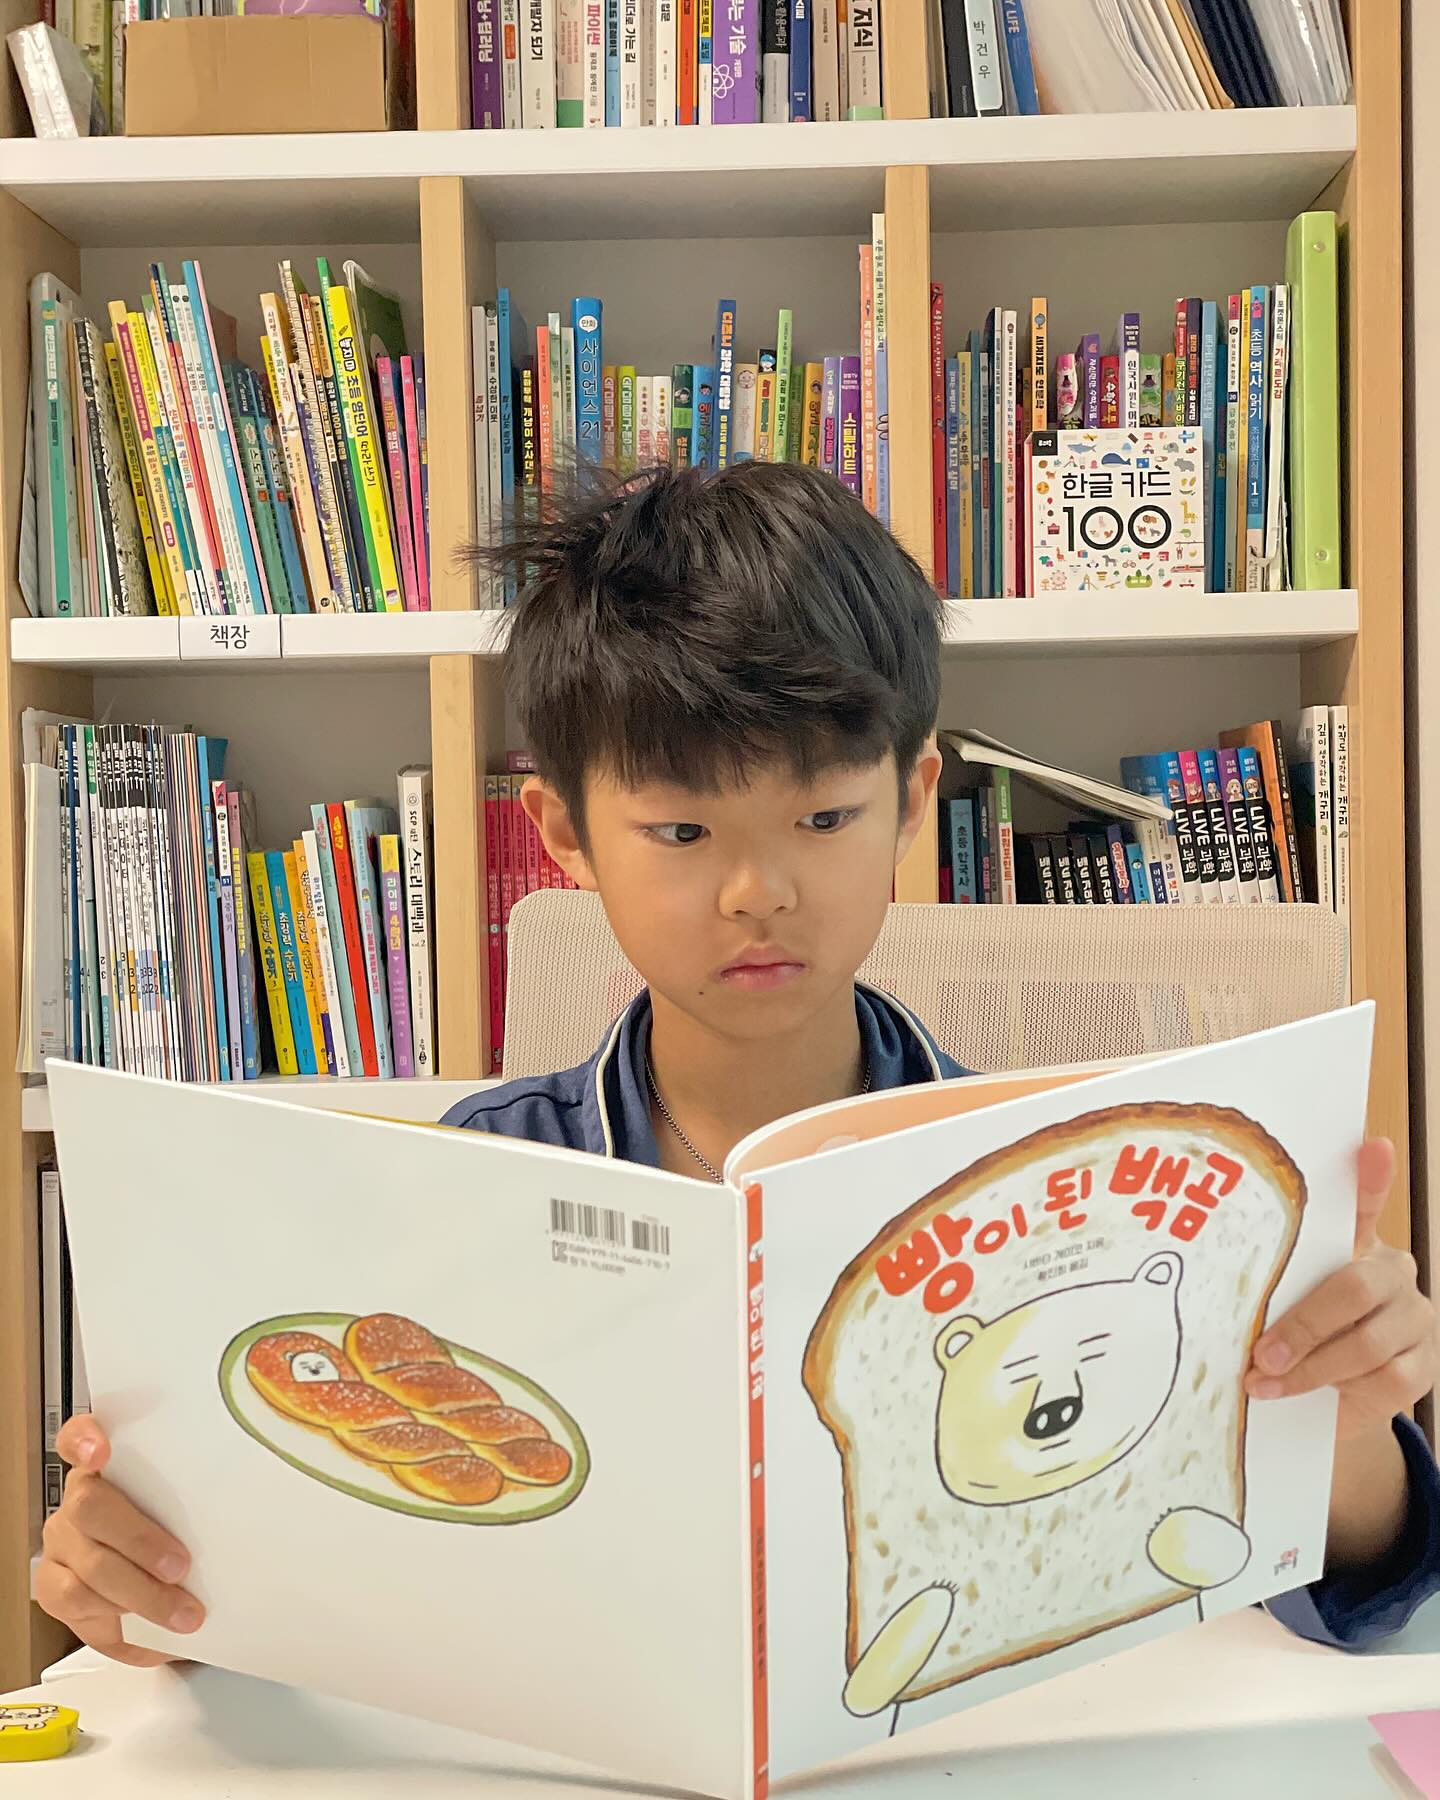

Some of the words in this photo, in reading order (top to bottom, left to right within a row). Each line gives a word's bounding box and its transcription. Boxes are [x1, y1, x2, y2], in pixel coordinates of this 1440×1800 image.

[587, 4, 601, 46] 파이썬
[661, 3, 671, 22] 입문
[1005, 10, 1020, 33] LIFE
[625, 28, 637, 50] 가는
[729, 25, 746, 55] 기술
[853, 8, 874, 47] 지식
[530, 36, 543, 61] 되기
[626, 52, 637, 63] 길
[973, 20, 991, 78] 박건우
[581, 319, 596, 328] 만화
[721, 312, 733, 347] 디즈니
[1035, 335, 1044, 375] 세계지도
[1250, 329, 1262, 356] 초등
[344, 360, 357, 372] 마
[720, 349, 732, 373] 과학
[1128, 361, 1137, 390] 한국사
[1176, 360, 1185, 390] 쿠키런
[1250, 361, 1262, 388] 역사
[347, 375, 362, 398] 초등
[581, 339, 598, 415] 사이언스
[1035, 380, 1045, 409] 인문학
[1101, 382, 1117, 424] 수학도둑
[1129, 392, 1137, 409] 읽는
[1250, 393, 1262, 420] 읽기
[169, 409, 180, 431] 신나는
[352, 401, 368, 437] 영단어
[1176, 395, 1185, 427] 서바이
[581, 420, 600, 439] 21
[843, 413, 857, 475] 스틸하트
[359, 440, 373, 465] 따라
[524, 441, 534, 470] 수사대
[948, 447, 957, 466] 되고
[249, 446, 270, 490] 스도쿠
[266, 445, 287, 490] 스도쿠
[363, 465, 377, 487] 쓰기
[948, 470, 957, 489] 싶어
[1062, 472, 1113, 499] 한글
[1121, 470, 1171, 498] 카드
[1062, 504, 1172, 551] 100
[210, 624, 250, 650] 책장
[1317, 723, 1327, 746] 깊이
[1337, 724, 1347, 751] 아직도
[1319, 749, 1327, 786] 생각하는
[1338, 754, 1347, 792] 생각하는
[409, 810, 417, 826] SCP
[1318, 790, 1329, 820] 개구리
[1337, 796, 1348, 825] 개구리
[1175, 808, 1192, 844] LIVE
[1193, 810, 1210, 847] LIVE
[1210, 807, 1228, 844] LIVE
[1232, 808, 1249, 845] LIVE
[1250, 806, 1268, 843] LIVE
[408, 847, 422, 888] 스토리
[1181, 848, 1195, 875] 과학
[1199, 849, 1213, 875] 과학
[1217, 848, 1233, 874] 과학
[1239, 849, 1254, 875] 과학
[1257, 847, 1273, 873] 과학
[411, 893, 425, 934] 대백과
[875, 1203, 1028, 1314] 빵이
[1044, 1168, 1092, 1231] 된
[1108, 1144, 1244, 1242] 백곰
